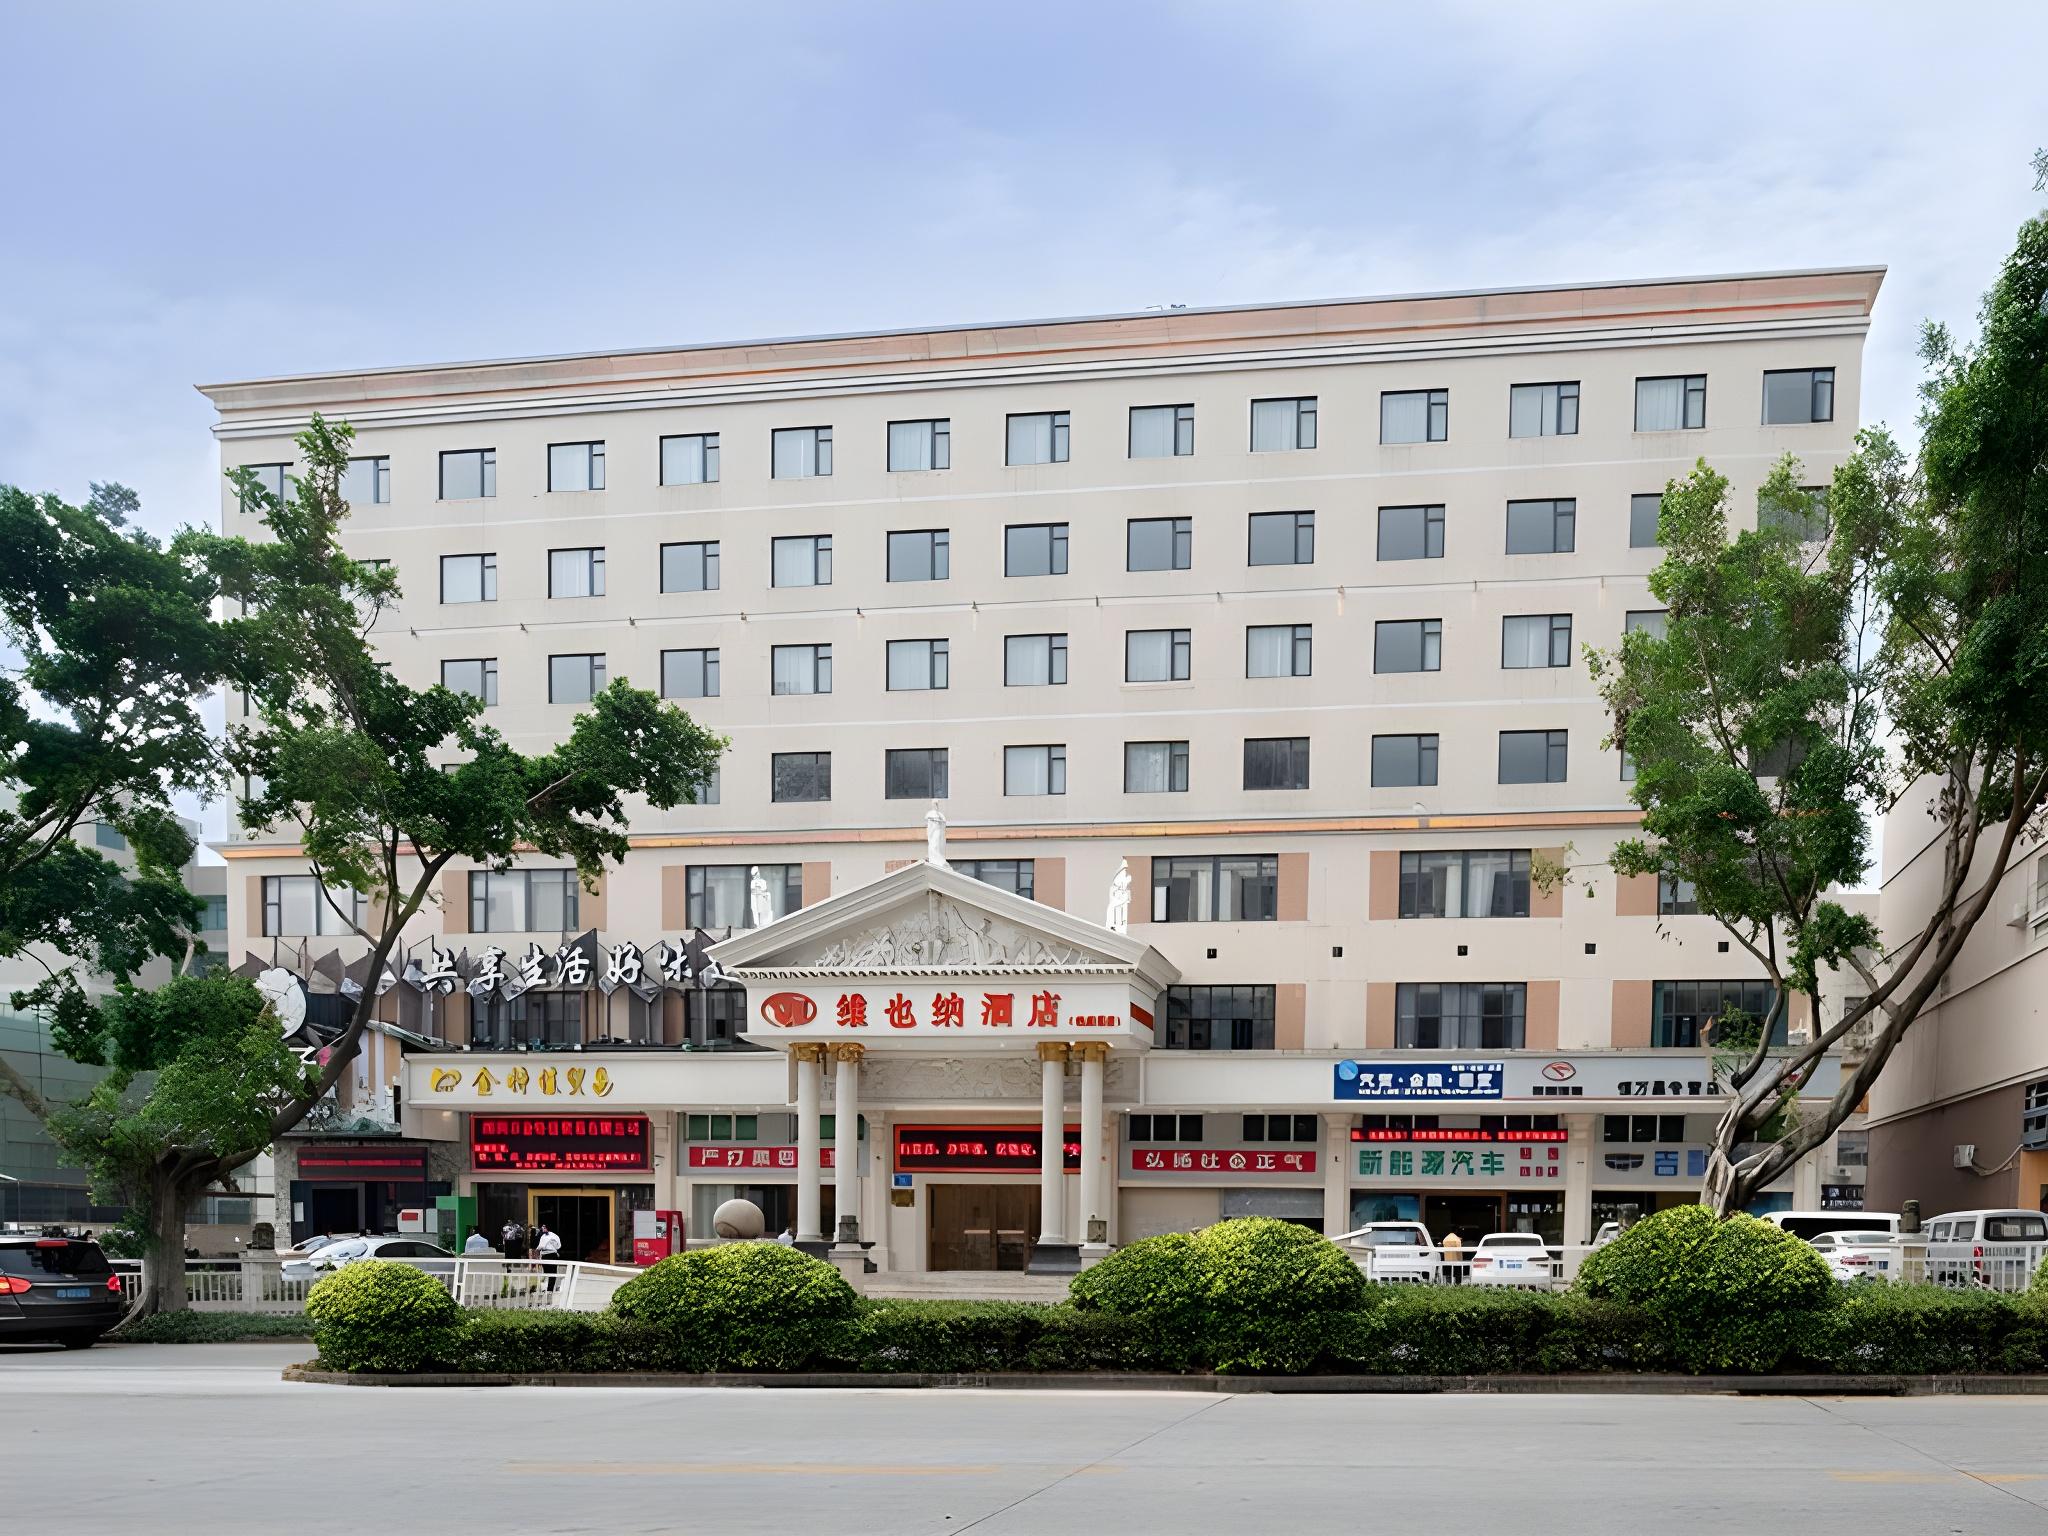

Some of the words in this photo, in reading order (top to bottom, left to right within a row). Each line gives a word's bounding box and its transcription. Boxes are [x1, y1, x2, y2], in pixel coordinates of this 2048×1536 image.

[836, 990, 1062, 1028] 维也纳酒店
